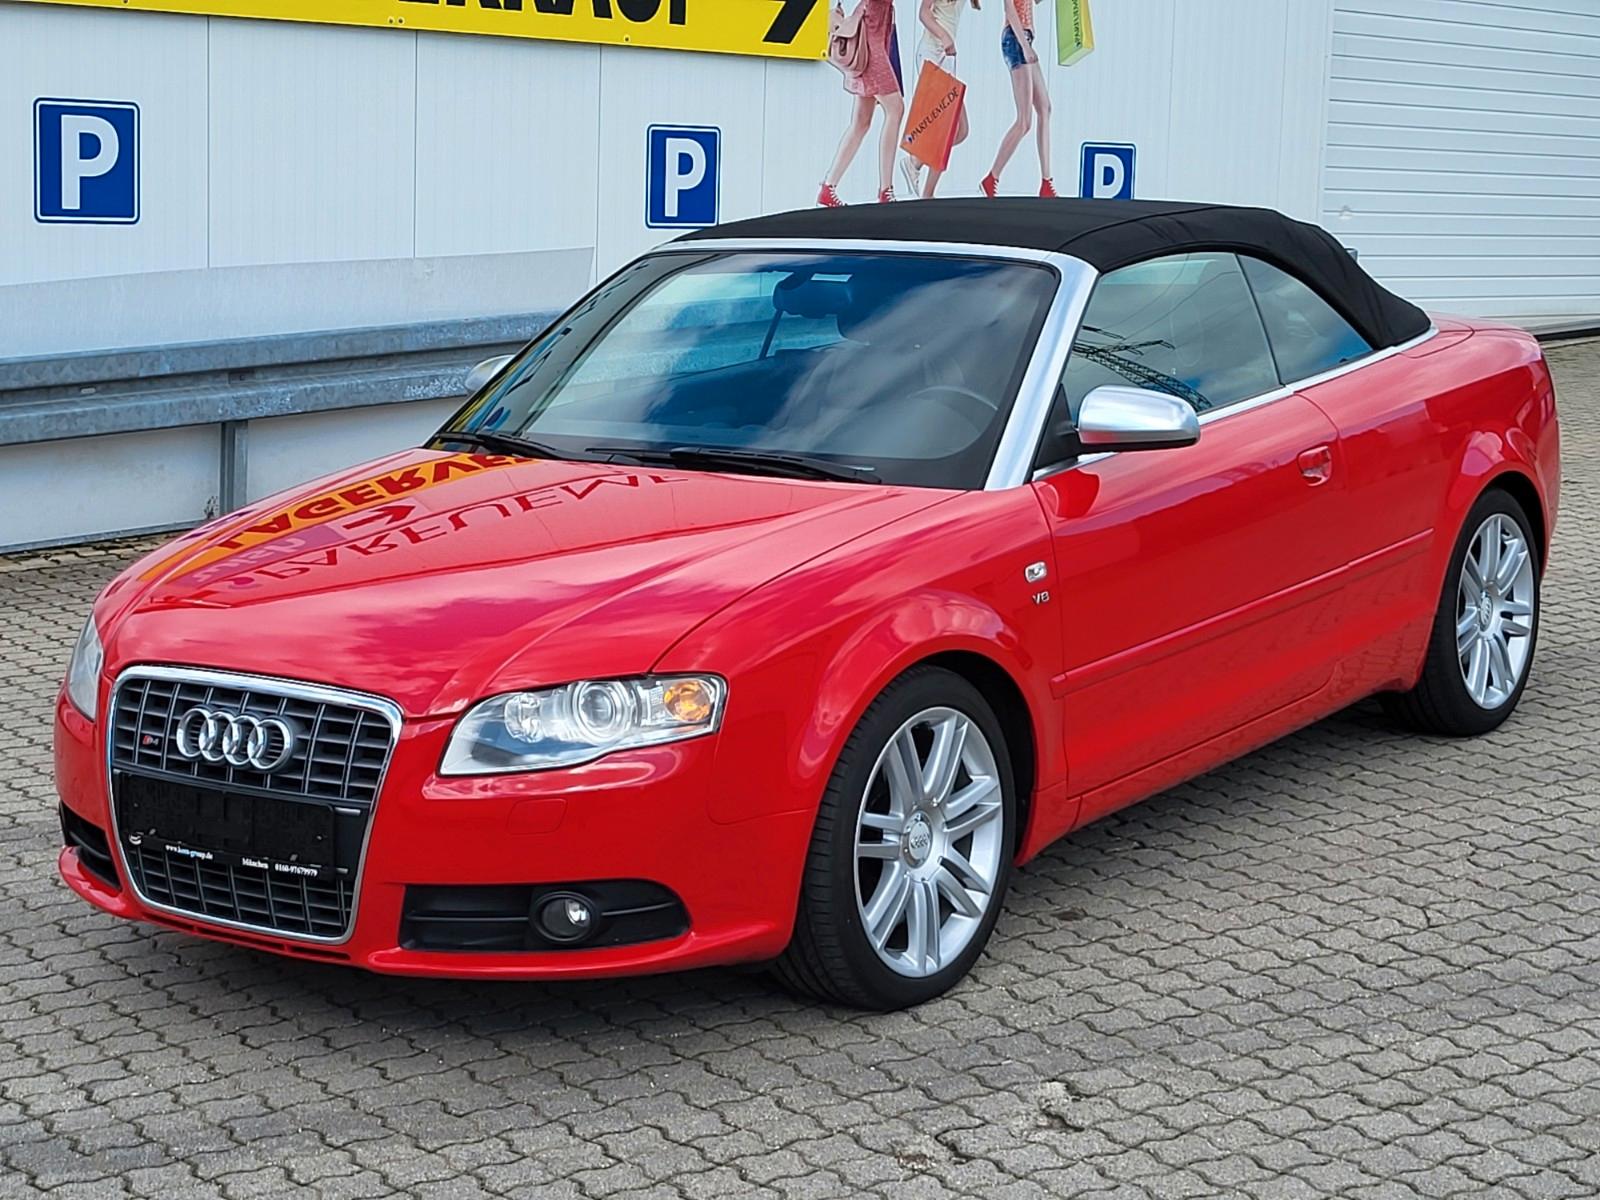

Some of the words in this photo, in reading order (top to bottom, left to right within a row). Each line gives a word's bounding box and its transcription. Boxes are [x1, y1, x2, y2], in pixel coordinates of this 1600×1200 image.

[61, 114, 119, 210] P
[664, 137, 706, 217] P
[1032, 591, 1049, 604] V8
